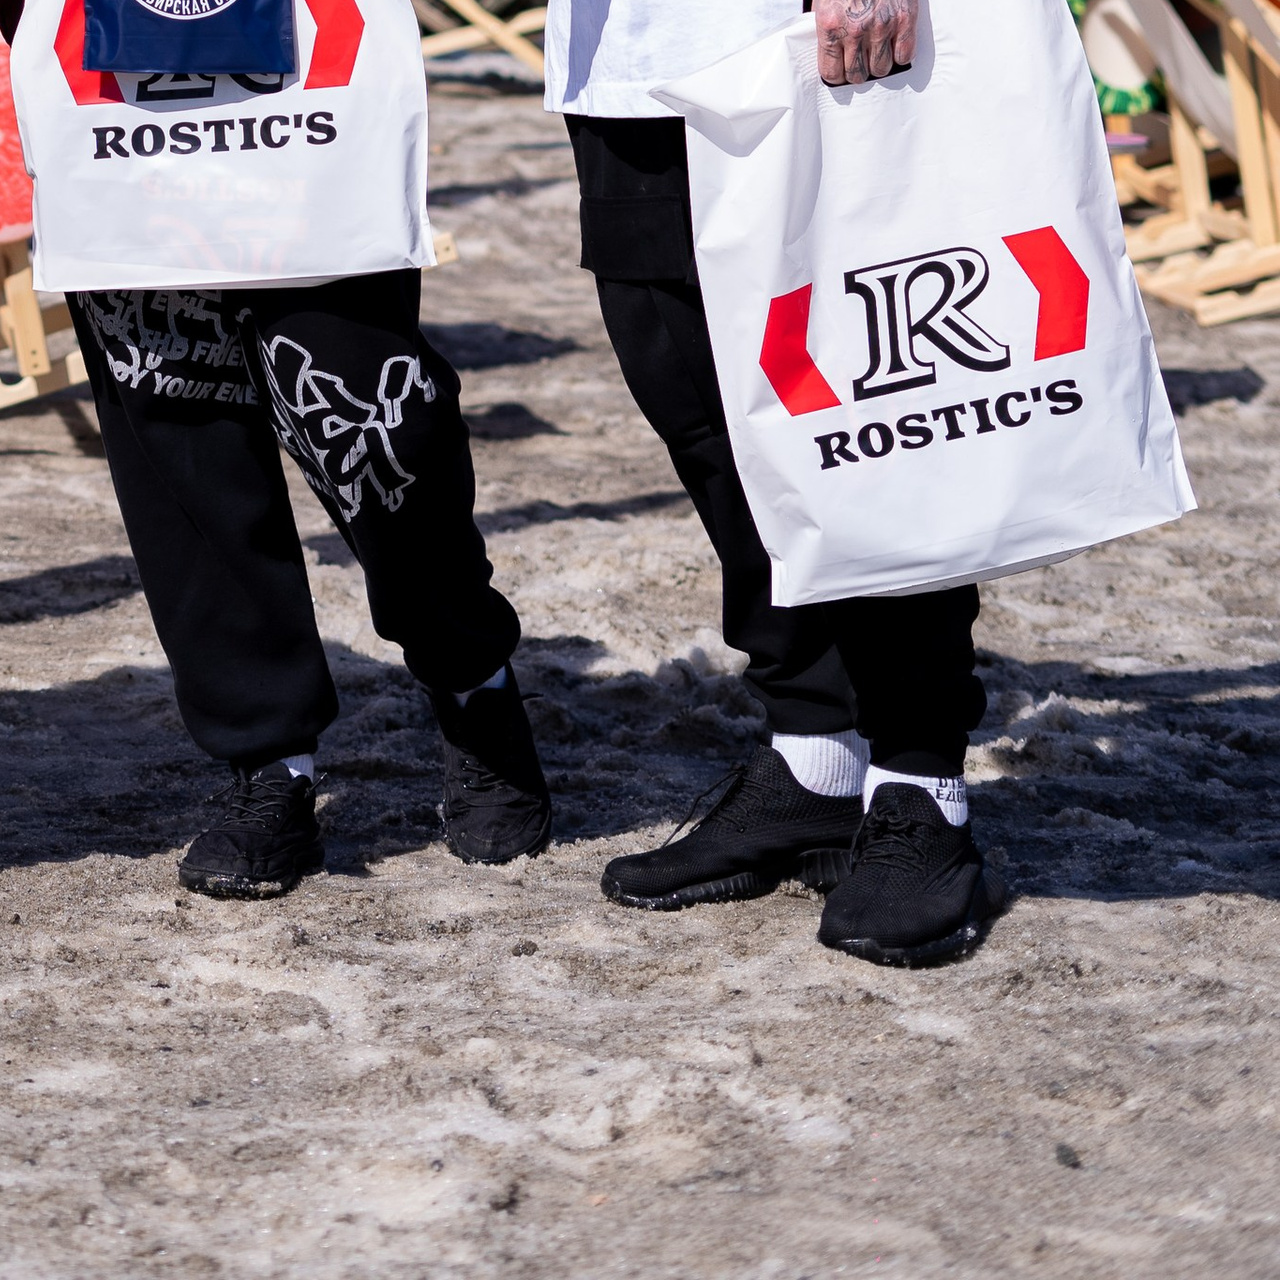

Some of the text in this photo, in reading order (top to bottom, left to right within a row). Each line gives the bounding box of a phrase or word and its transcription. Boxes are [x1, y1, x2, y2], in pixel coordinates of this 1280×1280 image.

[92, 111, 338, 159] ROSTIC'S
[843, 246, 1011, 402] R
[153, 371, 216, 400] YOUR
[216, 383, 260, 405] ENE
[814, 379, 1084, 470] ROSTIC'S
